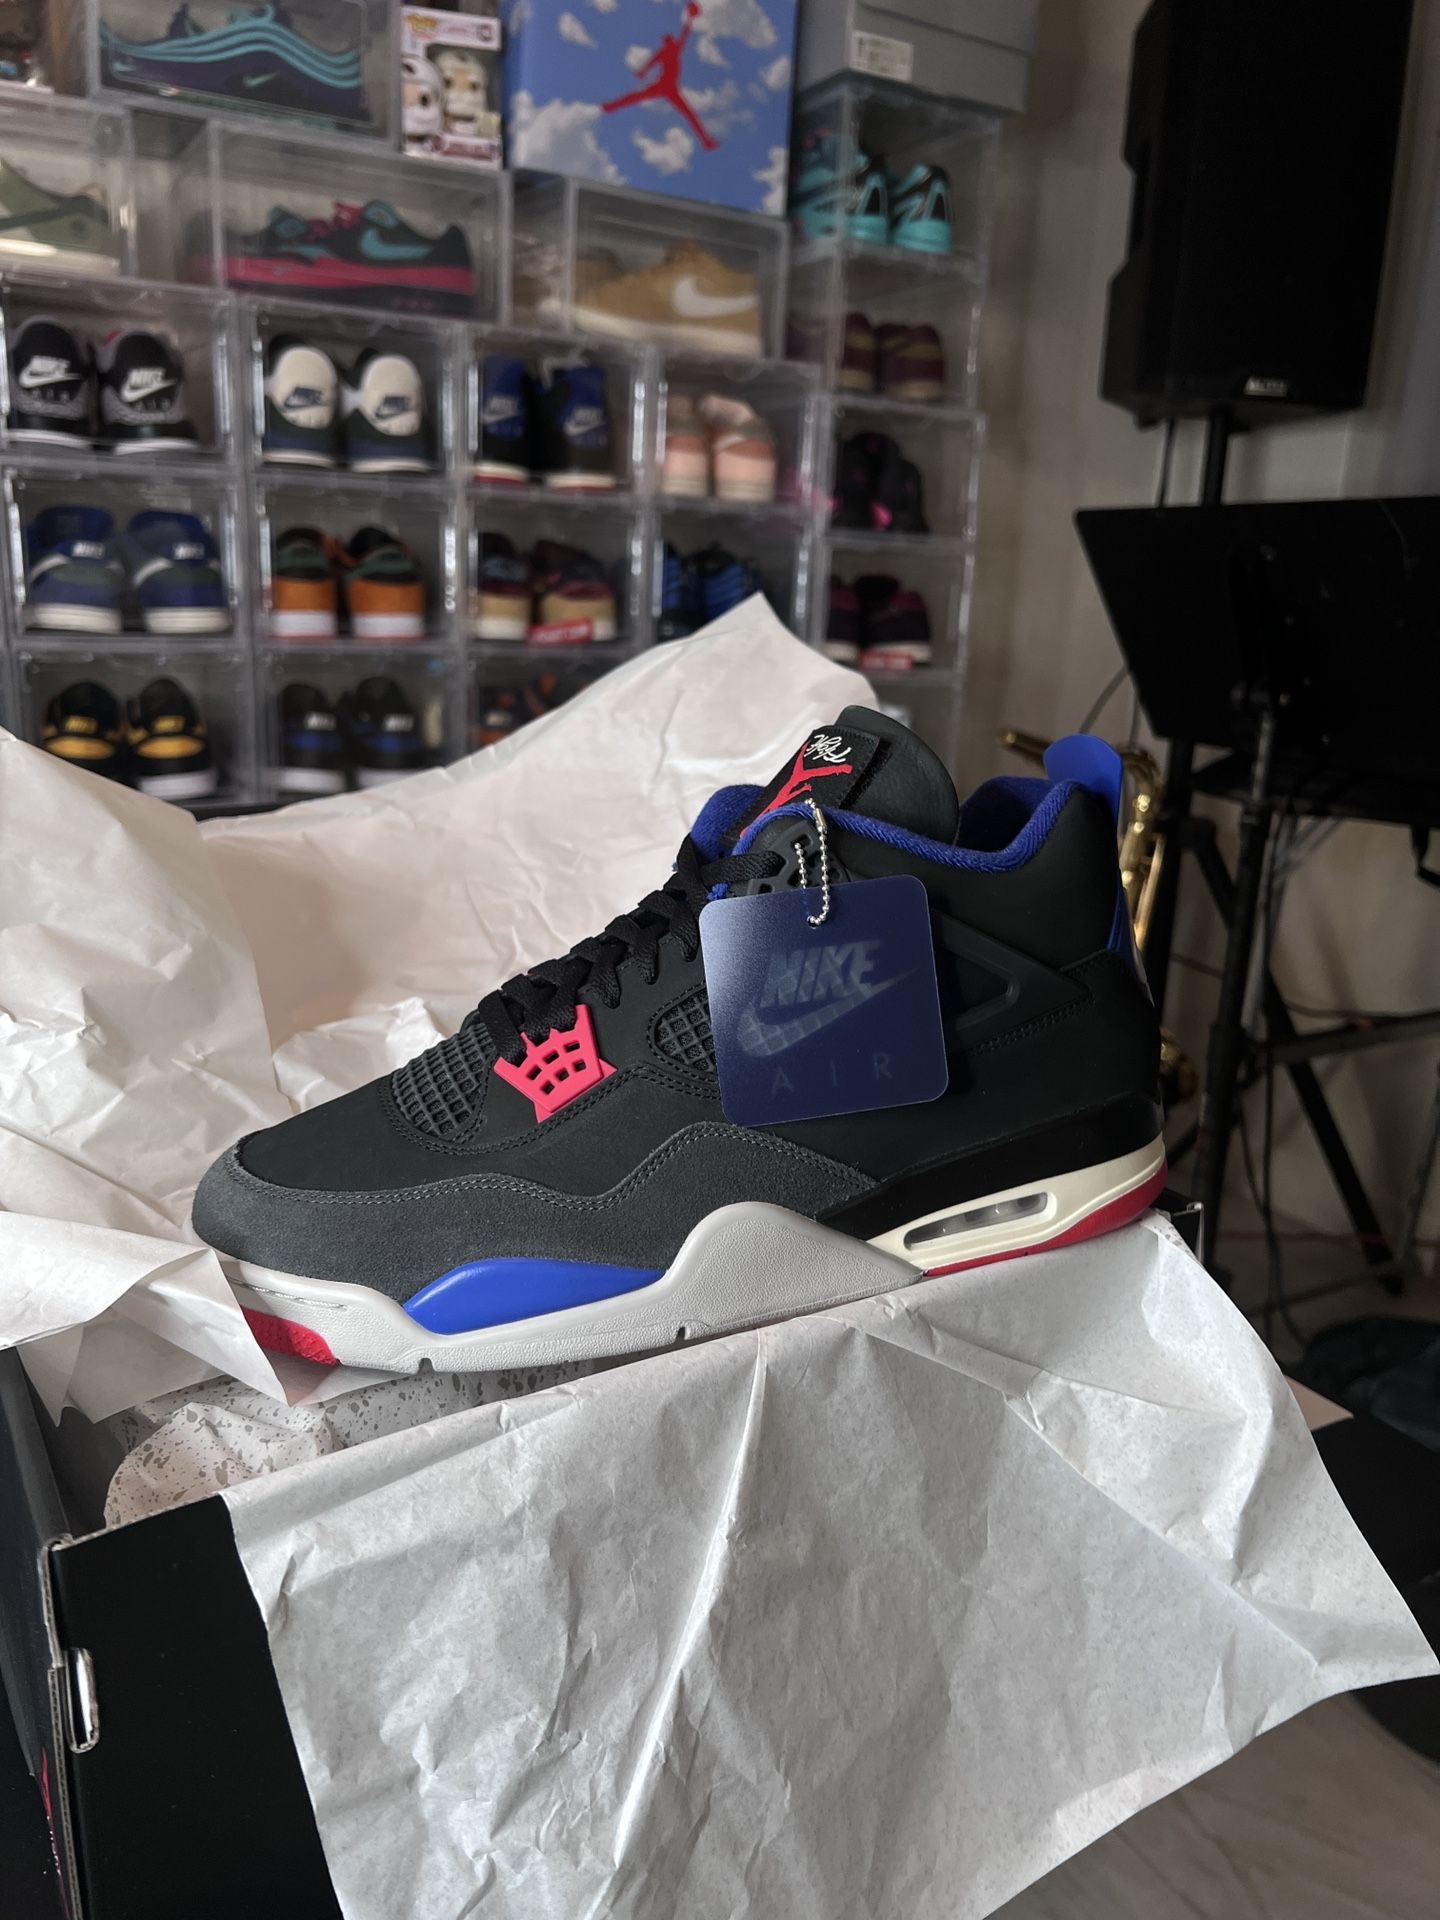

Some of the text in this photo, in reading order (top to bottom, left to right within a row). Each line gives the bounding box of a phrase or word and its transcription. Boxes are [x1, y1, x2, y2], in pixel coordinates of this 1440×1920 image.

[30, 355, 71, 376] NIKE
[129, 367, 168, 389] NIKE
[759, 939, 882, 1009] NIKE
[771, 1052, 893, 1096] AIR
